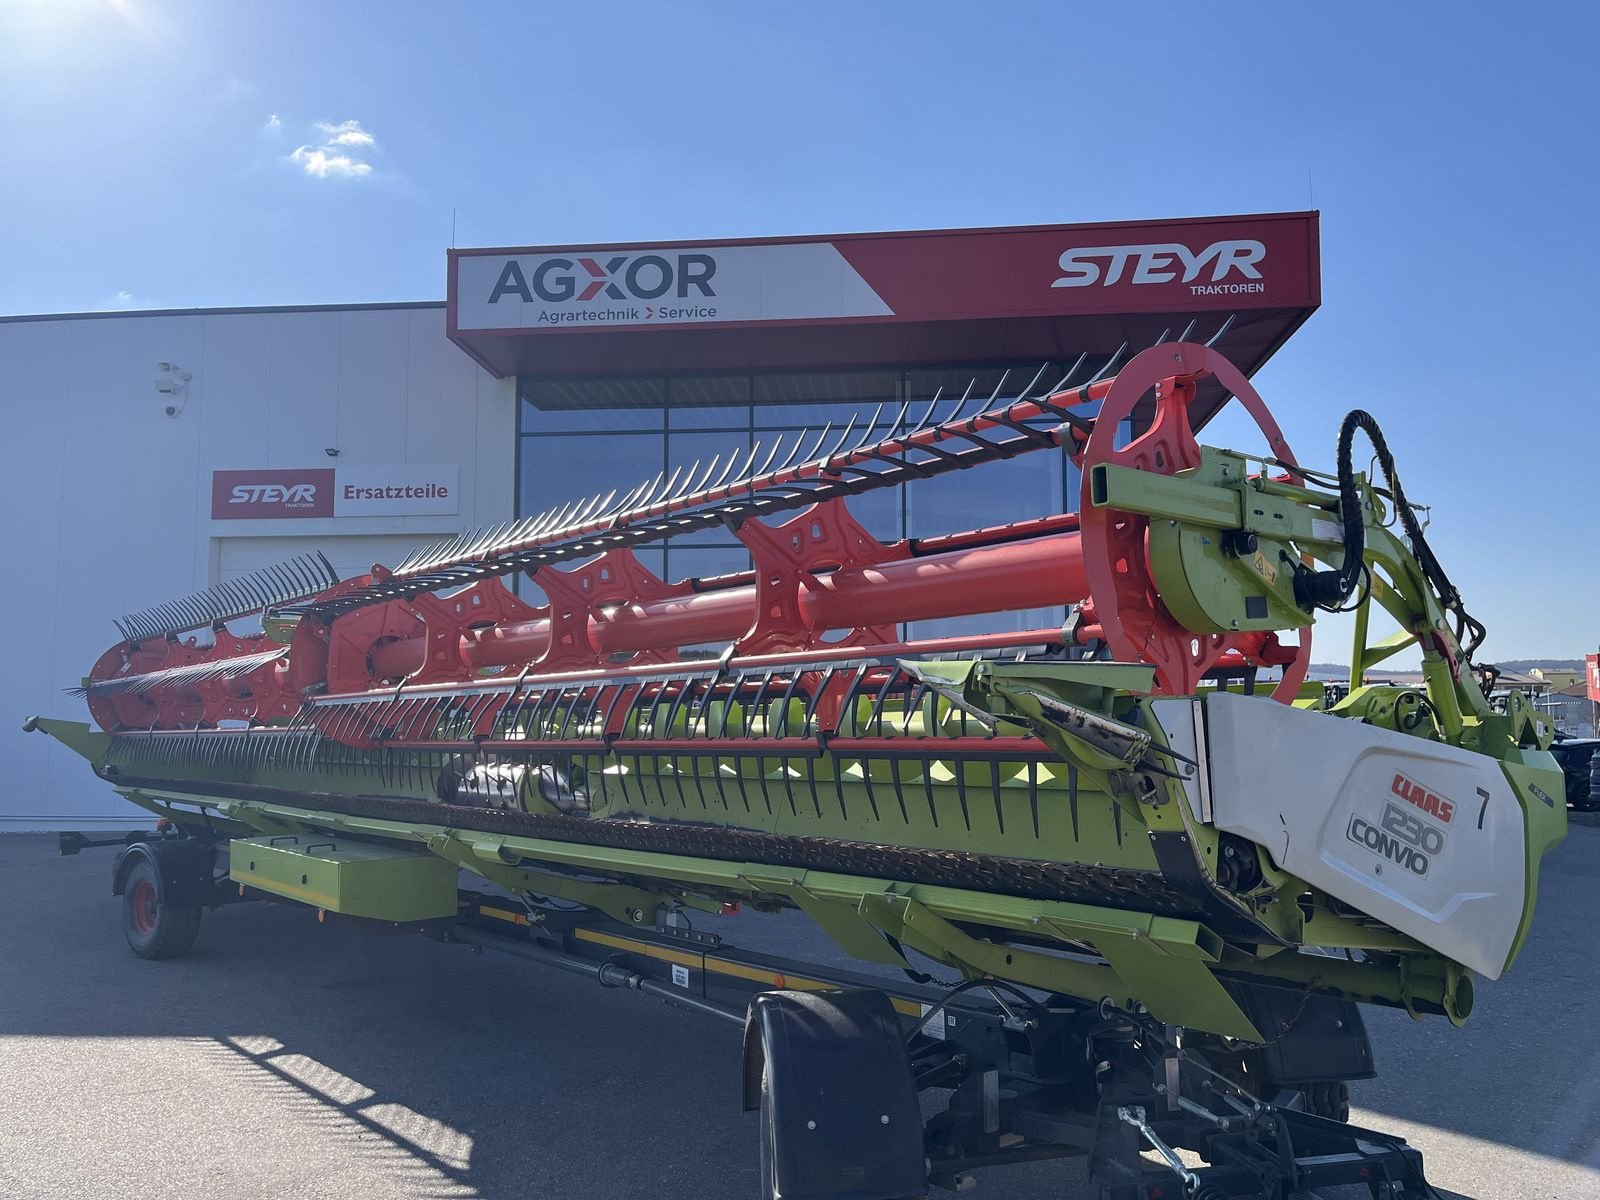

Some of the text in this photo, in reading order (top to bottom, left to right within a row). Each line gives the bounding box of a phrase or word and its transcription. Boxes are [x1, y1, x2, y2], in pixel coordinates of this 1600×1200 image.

[487, 253, 717, 304] AGXOR
[1050, 239, 1266, 288] STEYR
[1190, 283, 1265, 295] TRAKTOREN
[537, 304, 717, 324] Agrartechnik Service
[228, 484, 316, 503] STEYR
[343, 483, 448, 500] Ersatzteile
[1391, 773, 1453, 824] CLAAS
[1476, 786, 1490, 831] 7
[1351, 818, 1429, 876] CONVIO
[1381, 803, 1444, 855] 1230
